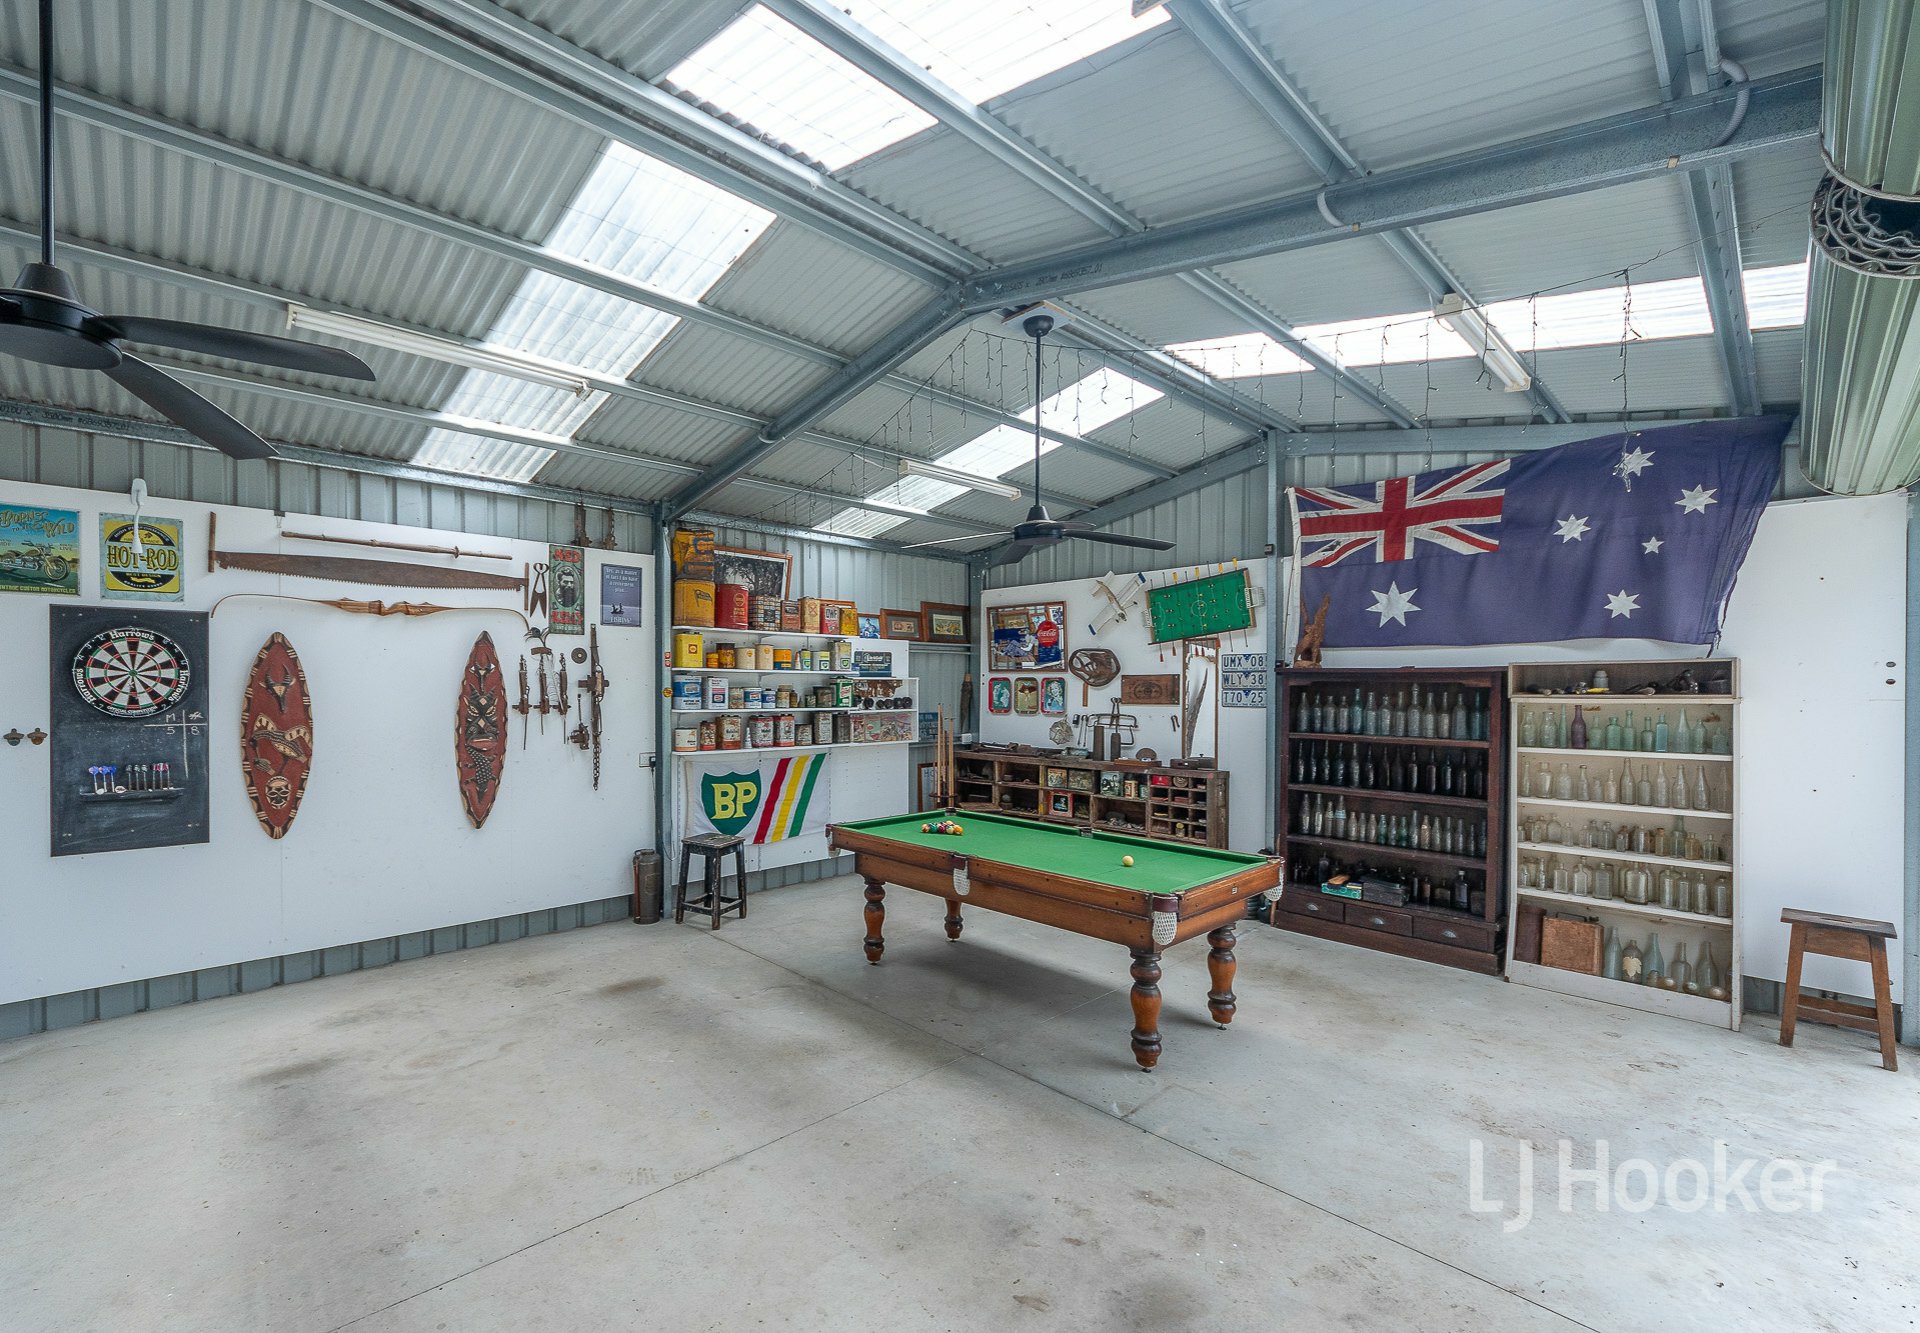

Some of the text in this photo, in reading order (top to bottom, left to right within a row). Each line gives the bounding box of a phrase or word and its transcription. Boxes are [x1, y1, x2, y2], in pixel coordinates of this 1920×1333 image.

[42, 518, 75, 538] WILD
[107, 544, 180, 571] HOT-ROD
[553, 548, 582, 564] NED
[109, 629, 155, 640] Harrows
[1223, 656, 1267, 667] UMX 08
[76, 668, 97, 703] Harrows
[168, 669, 189, 702] Harrows
[1223, 673, 1267, 685] WLY 38
[1251, 691, 1267, 703] 25
[166, 725, 200, 735] 5 8
[710, 781, 758, 820] BP
